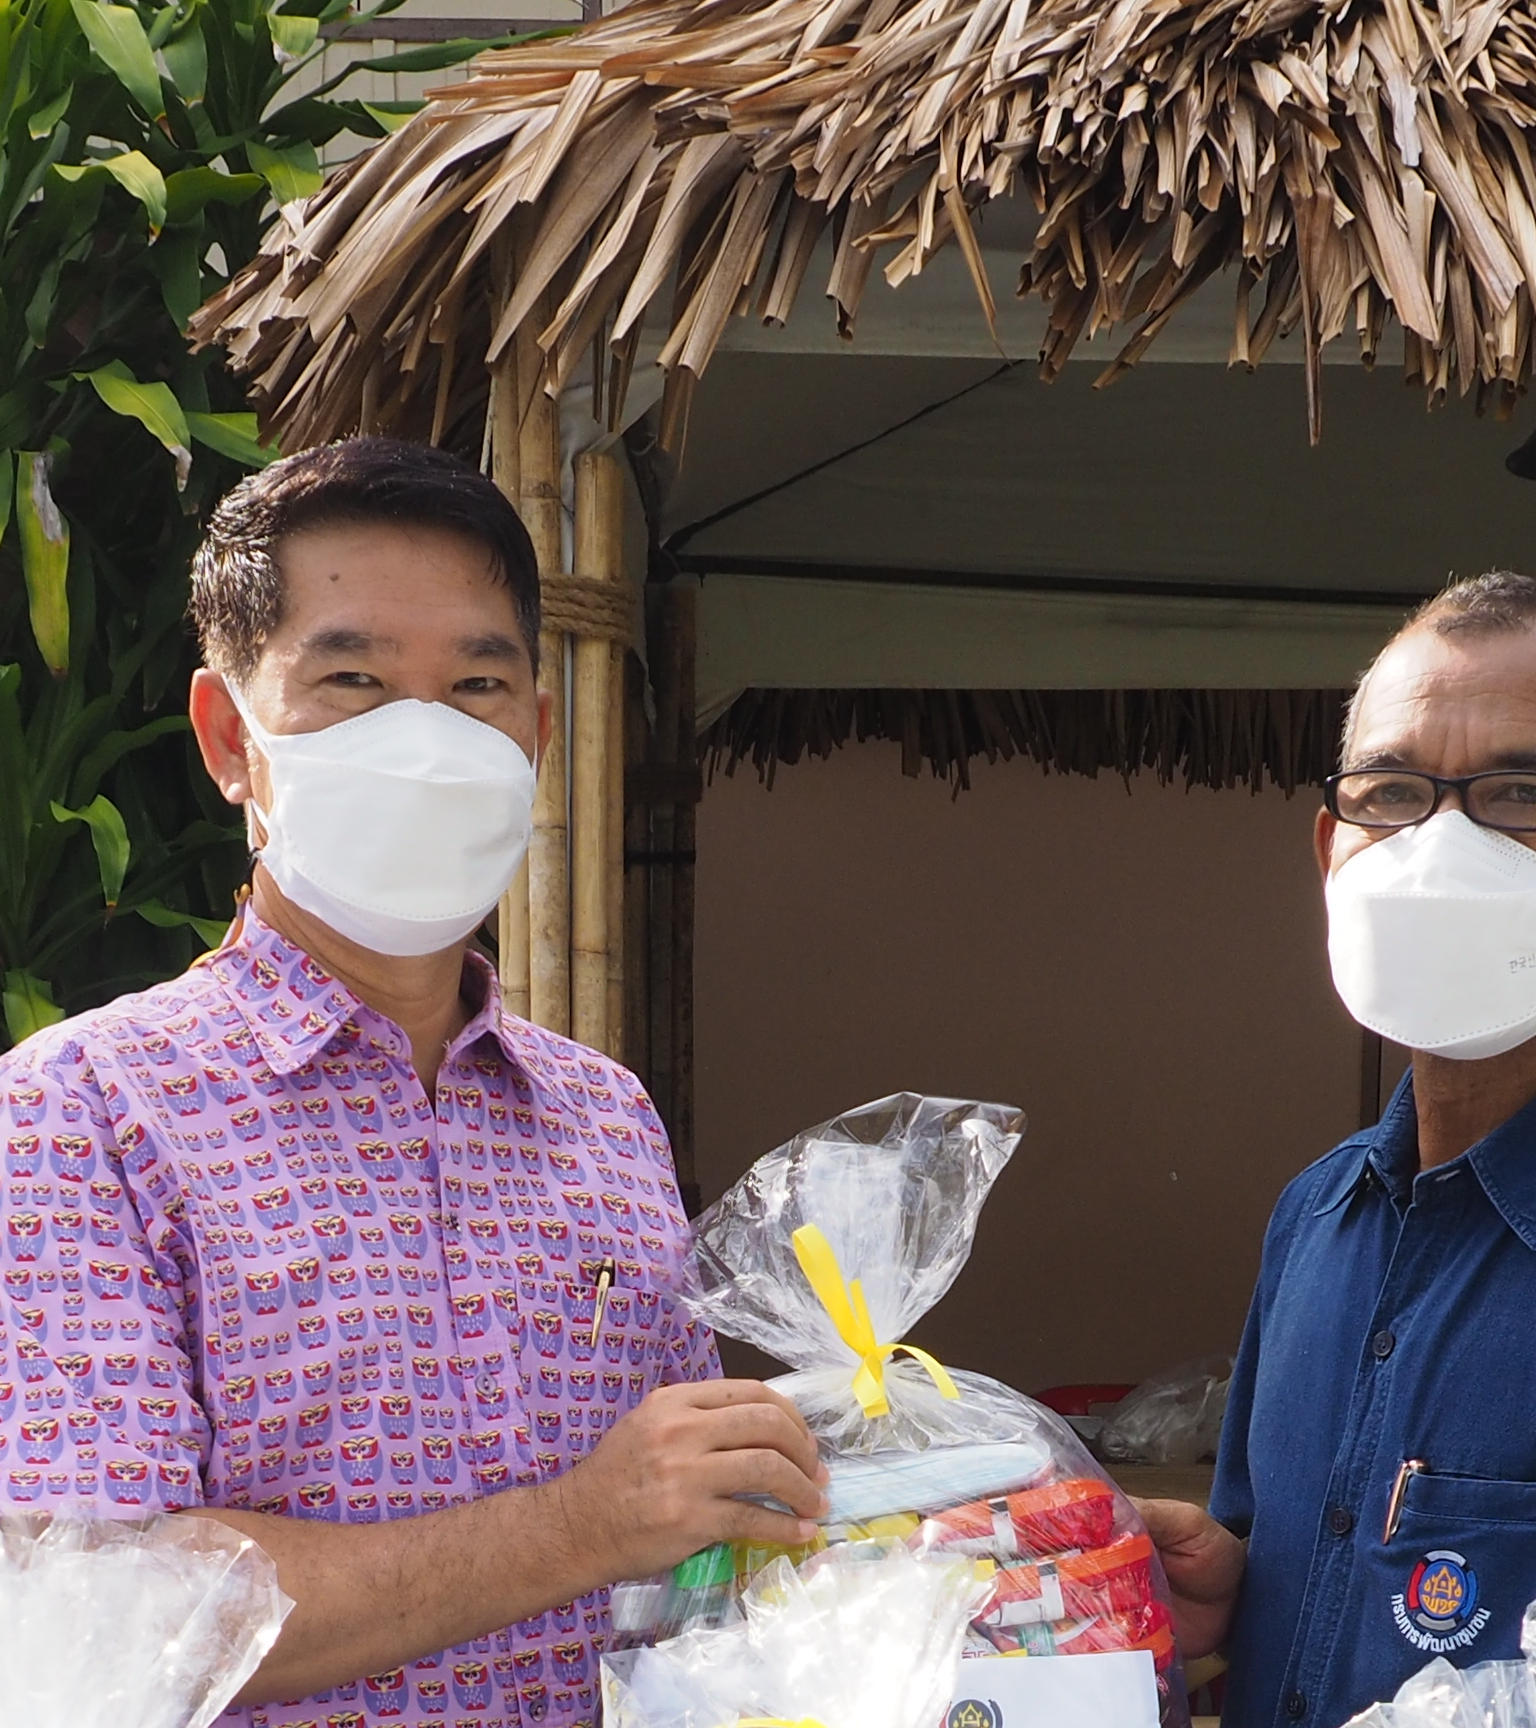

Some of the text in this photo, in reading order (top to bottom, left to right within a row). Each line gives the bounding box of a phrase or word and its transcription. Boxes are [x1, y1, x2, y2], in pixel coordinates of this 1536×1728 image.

[1390, 1593, 1492, 1653] กรมการพัฒนาชุมชน
